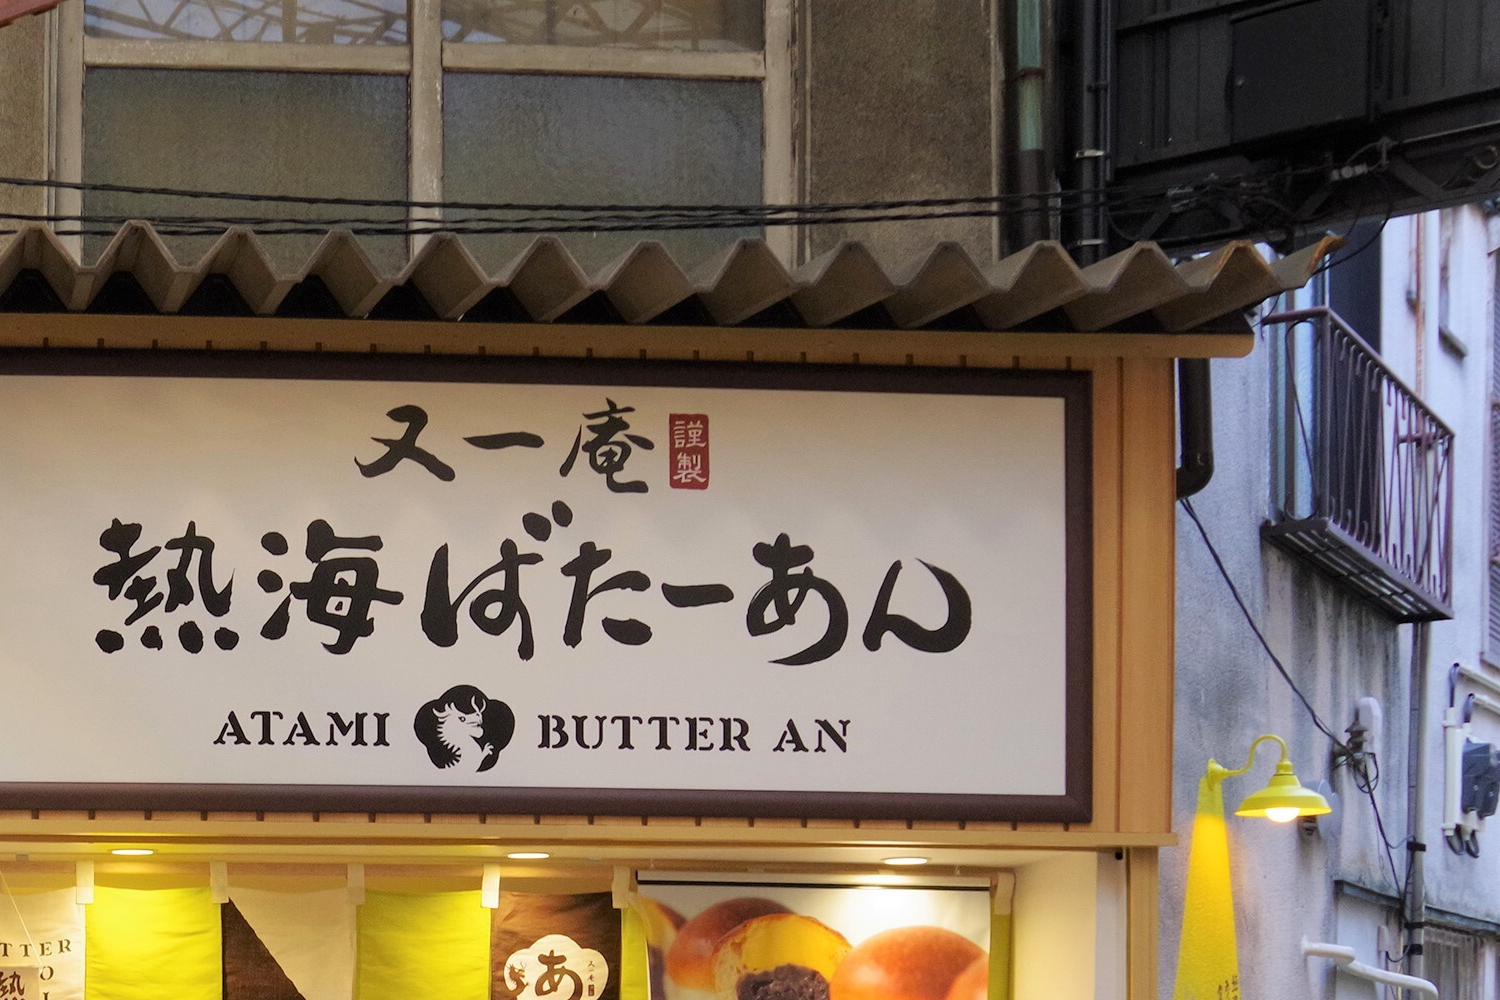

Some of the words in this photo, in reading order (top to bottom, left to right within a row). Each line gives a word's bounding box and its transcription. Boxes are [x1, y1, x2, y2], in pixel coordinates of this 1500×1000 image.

[354, 397, 654, 493] 又一庵
[94, 501, 972, 665] 熱海ばたーあん
[212, 709, 391, 746] ATAMI
[536, 714, 751, 752] BUTTER
[773, 718, 851, 753] AN
